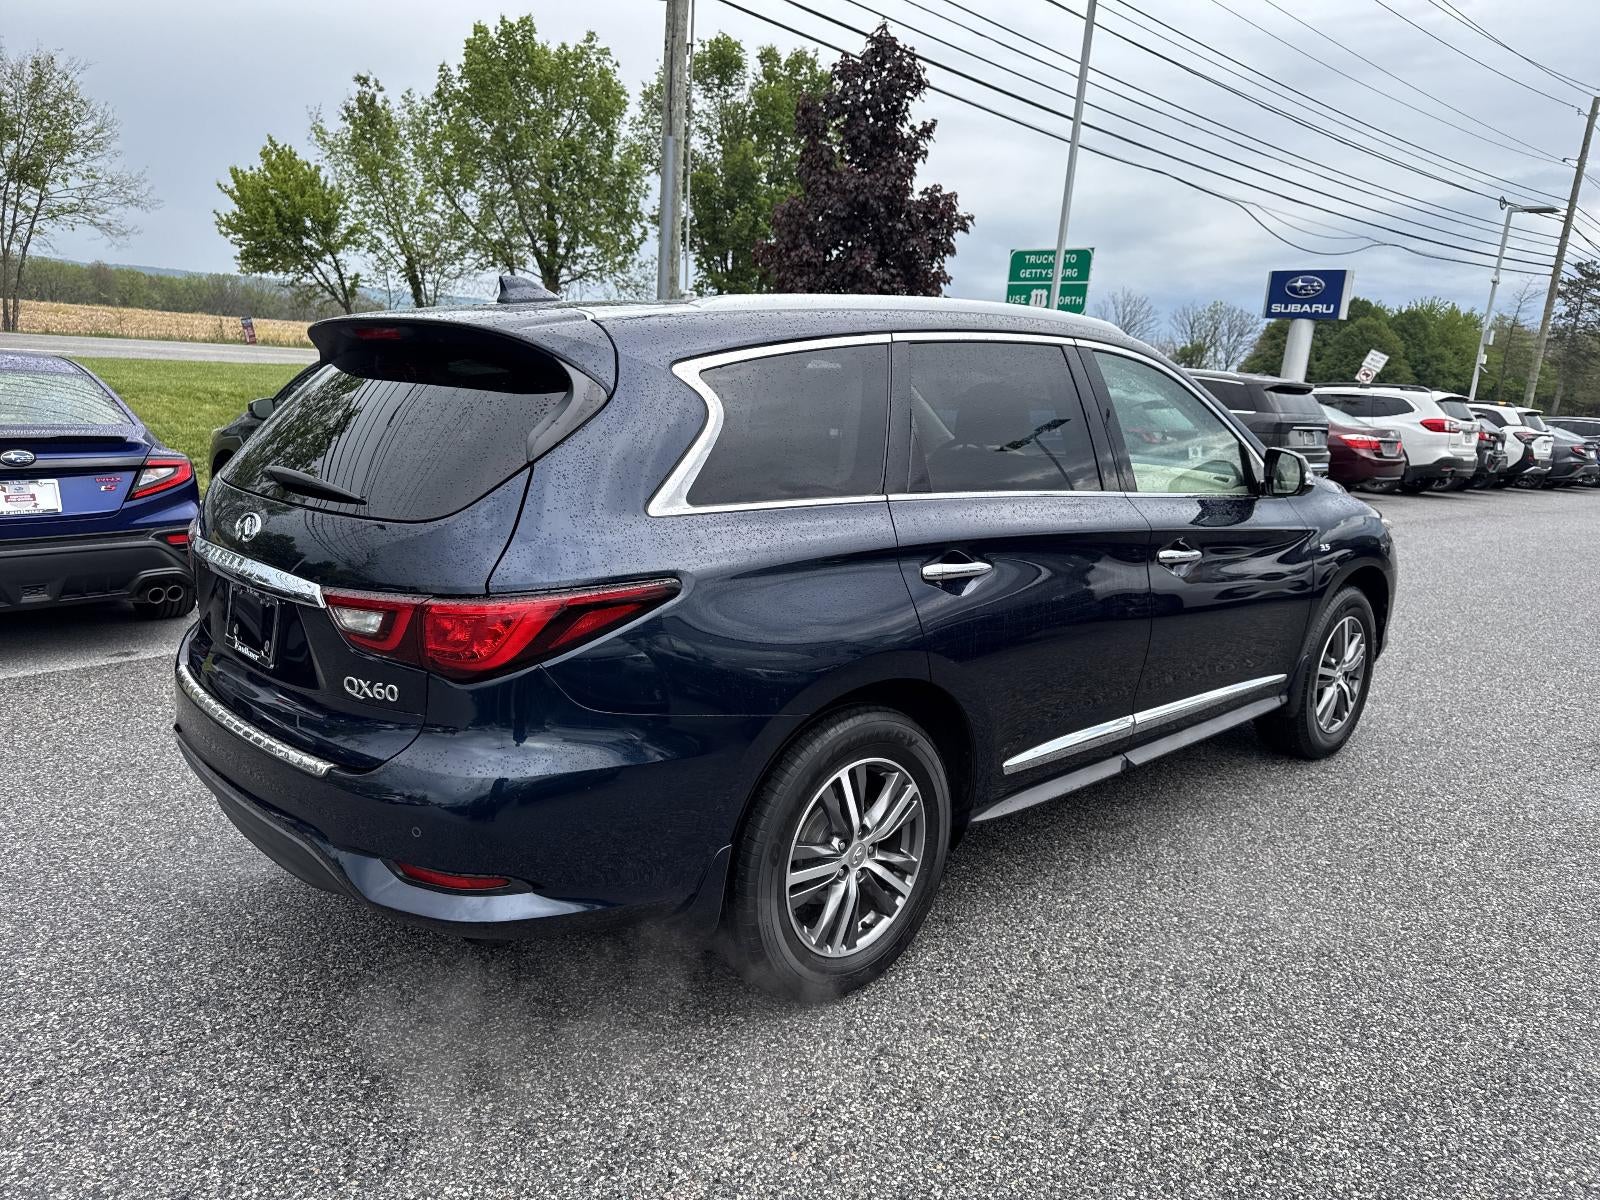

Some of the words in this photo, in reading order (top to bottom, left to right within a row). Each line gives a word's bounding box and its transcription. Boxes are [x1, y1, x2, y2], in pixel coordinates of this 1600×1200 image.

[1025, 254, 1056, 264] TRUCK
[1065, 254, 1077, 263] TO
[1020, 268, 1078, 278] GETTYSURG
[1008, 295, 1027, 304] USE
[1035, 293, 1043, 305] 11
[1057, 296, 1083, 305] ORTH
[1270, 303, 1335, 314] SUBARU
[234, 641, 260, 661] Faulkner
[343, 676, 400, 702] QX60
